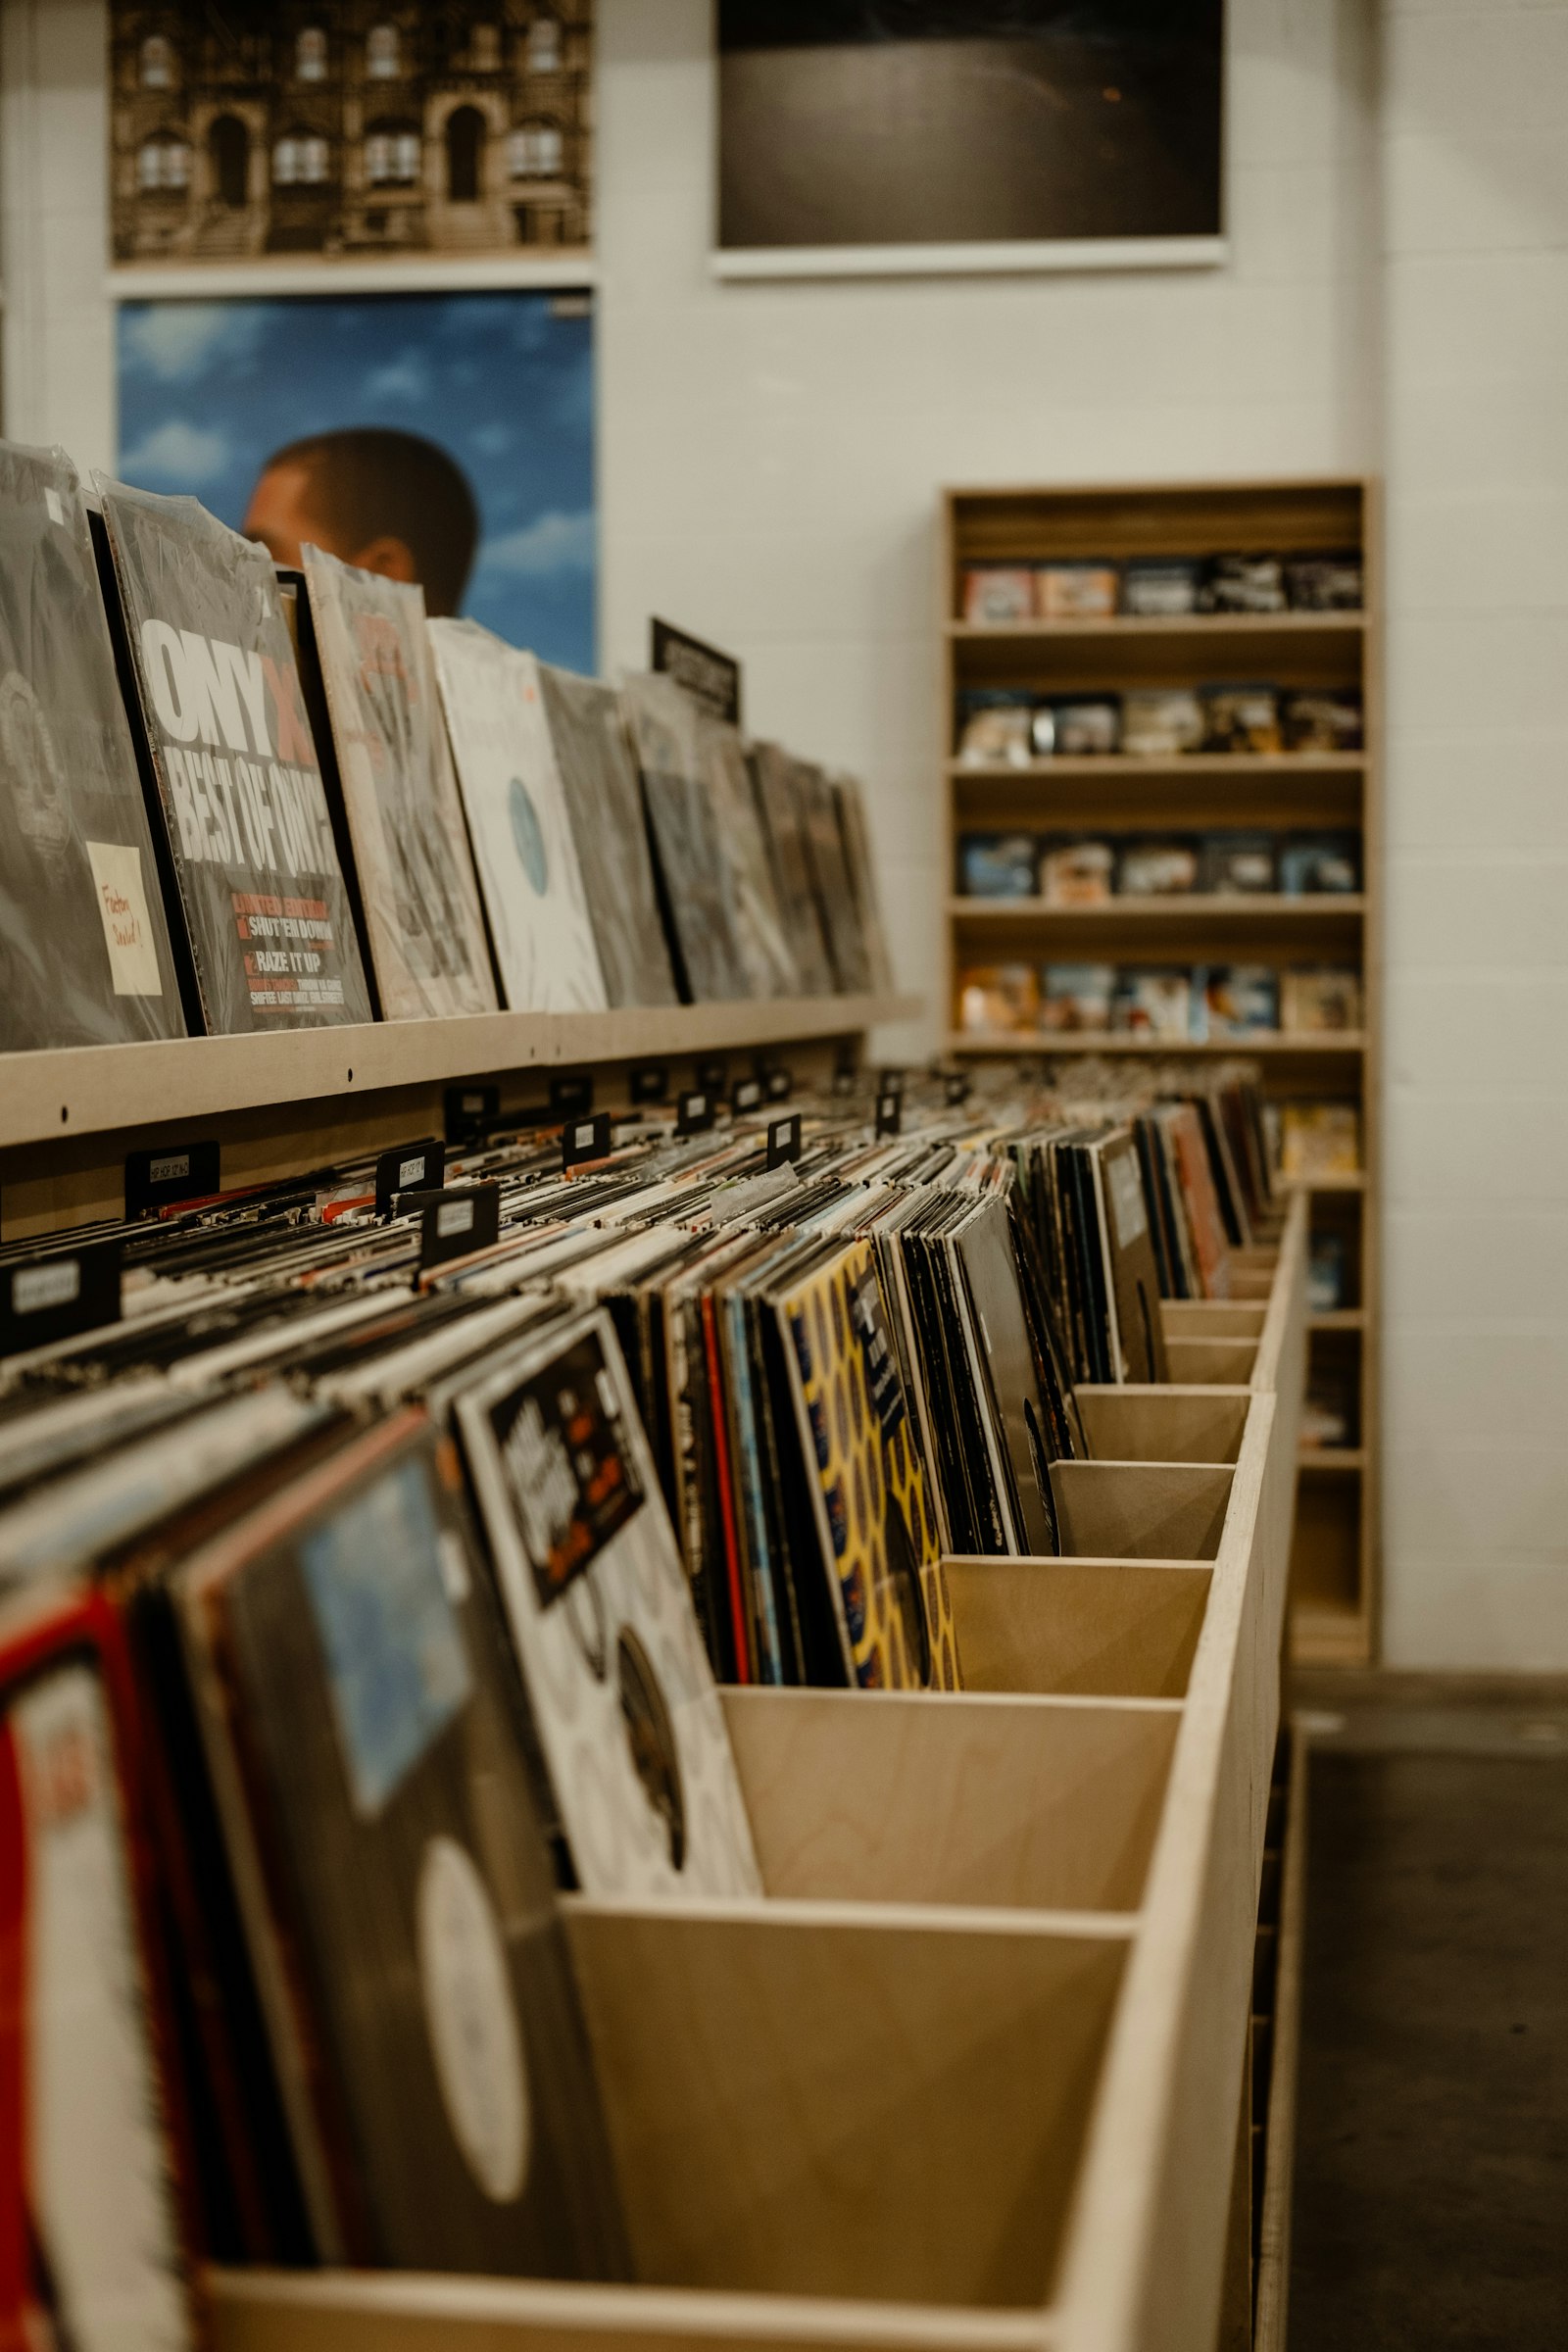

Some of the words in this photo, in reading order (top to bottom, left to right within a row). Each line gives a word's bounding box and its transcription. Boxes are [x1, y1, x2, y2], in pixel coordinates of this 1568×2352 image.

[141, 618, 315, 765] ONYX
[163, 746, 245, 863] BEST
[234, 756, 277, 870] OF
[249, 915, 280, 937] SHUT
[298, 919, 333, 940] DOWN
[256, 951, 289, 972] RAZE
[289, 952, 303, 972] IT
[303, 953, 320, 972] UP
